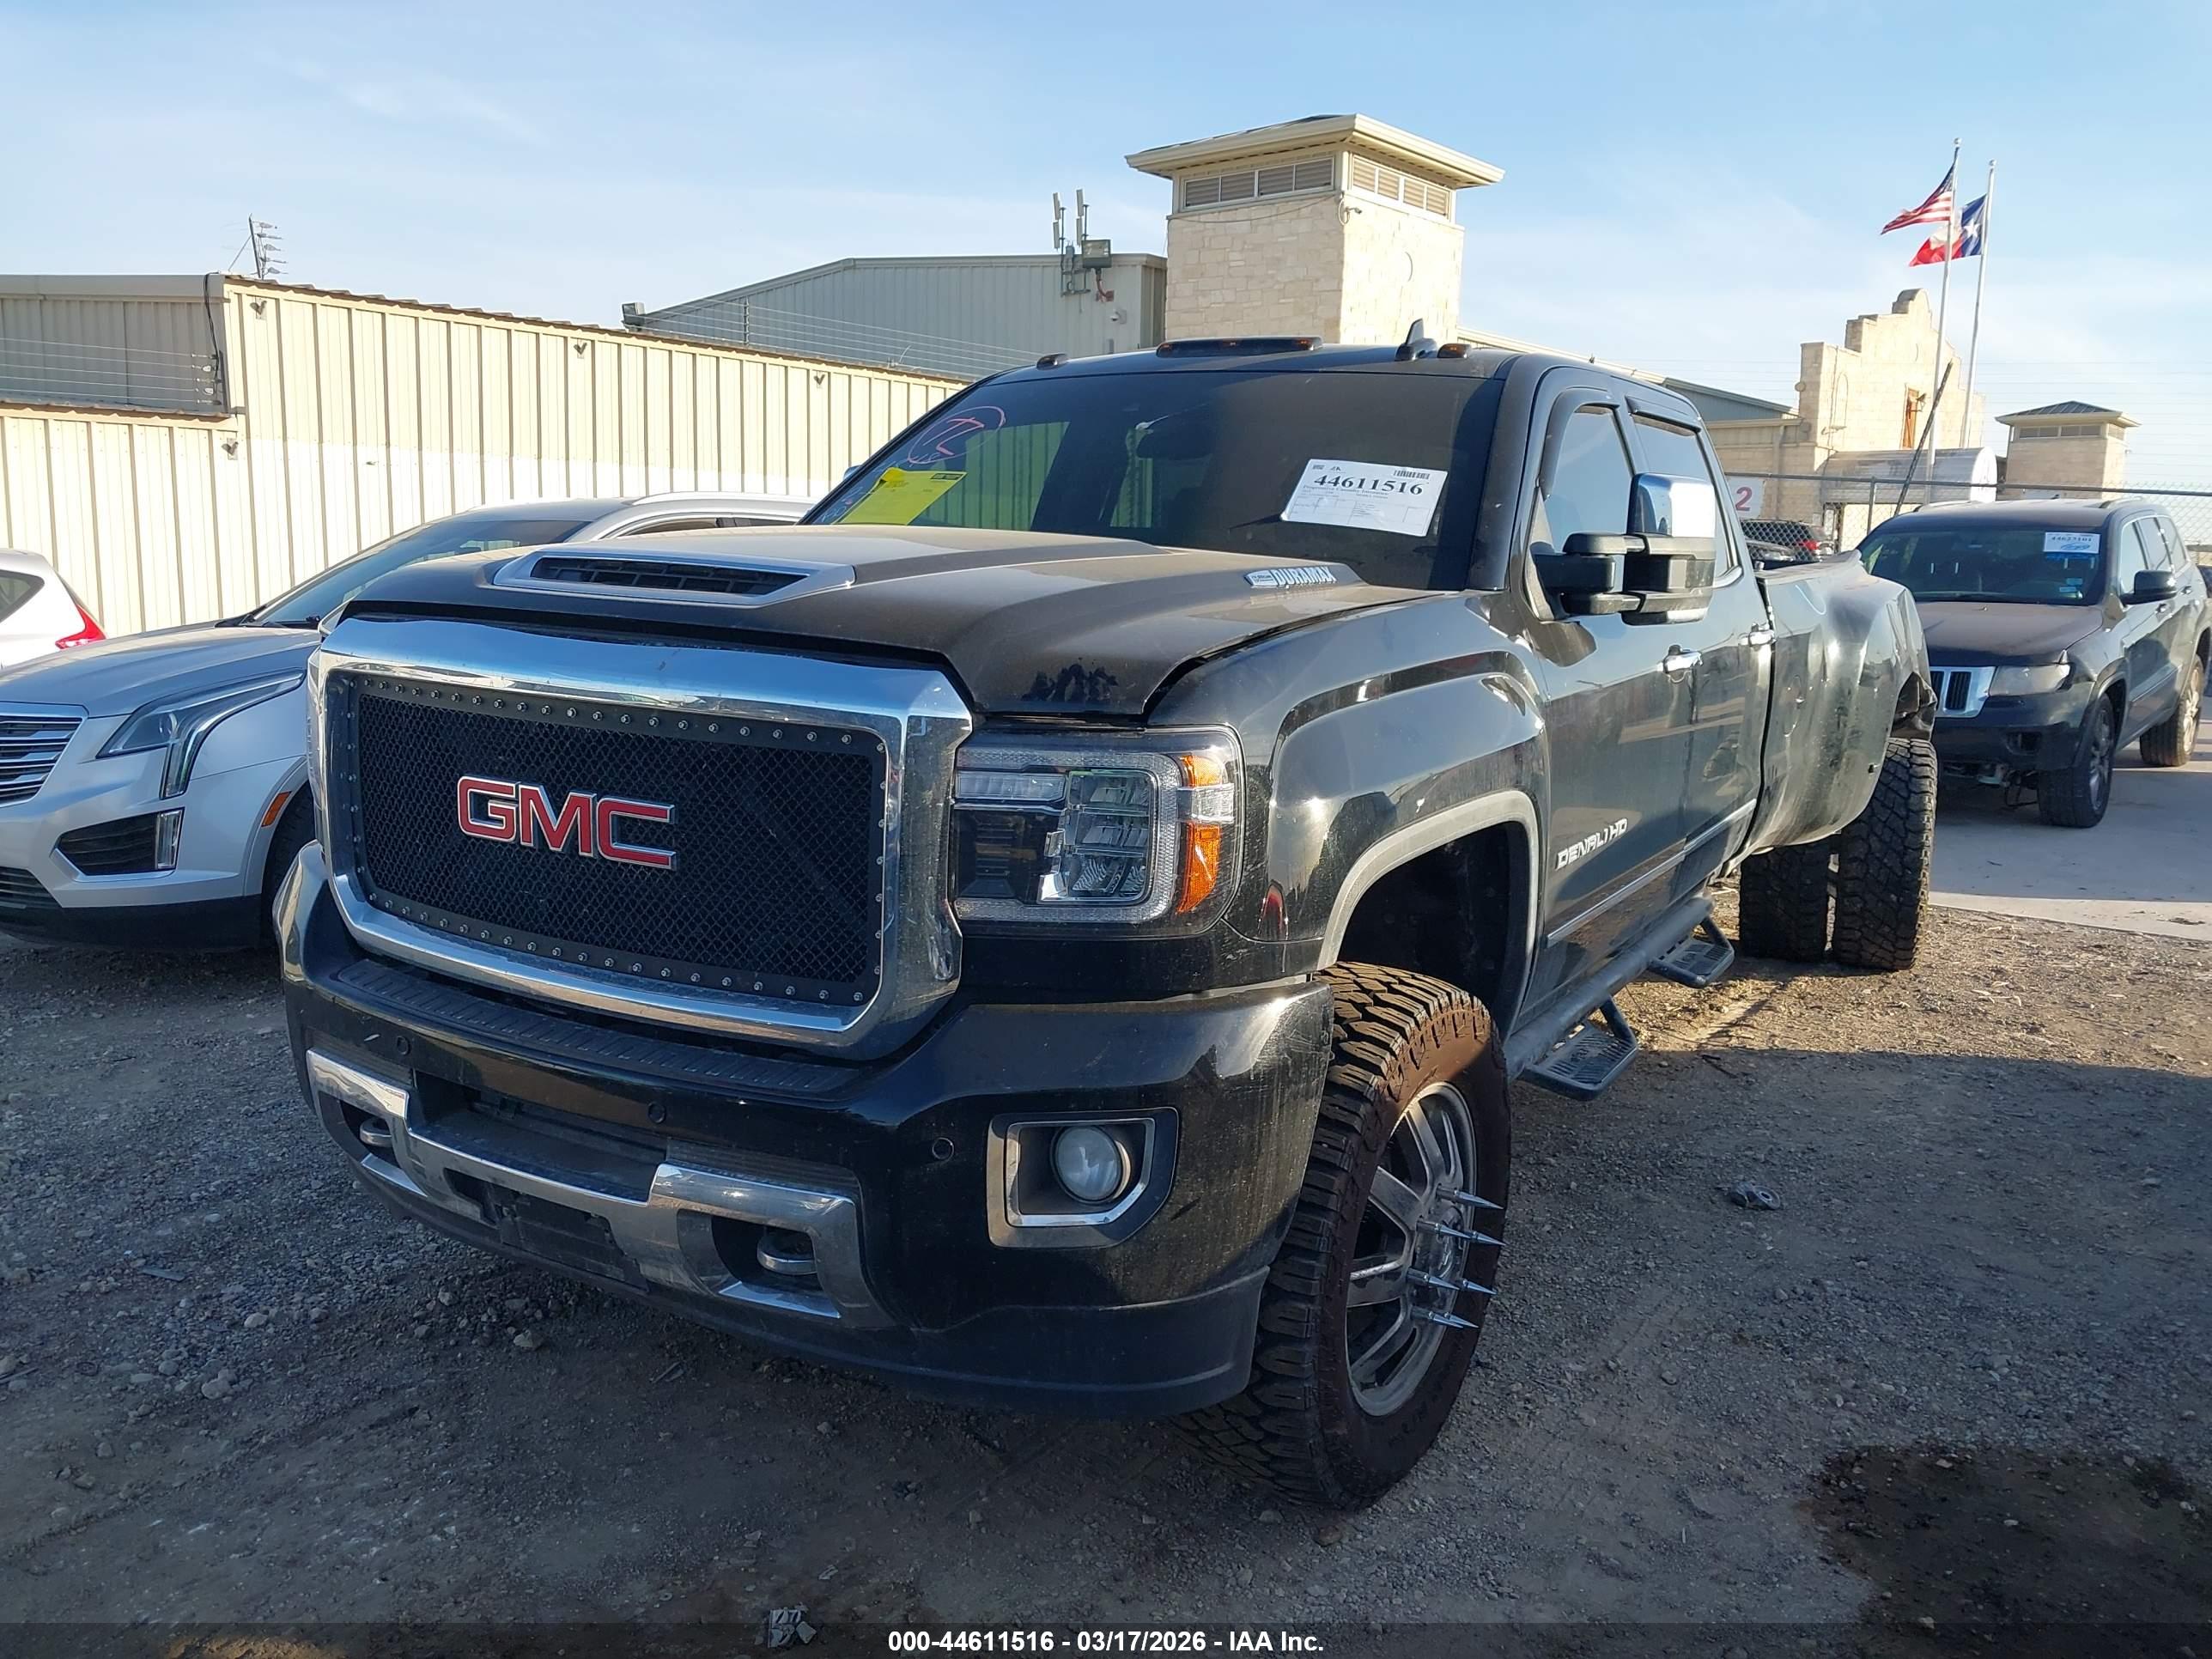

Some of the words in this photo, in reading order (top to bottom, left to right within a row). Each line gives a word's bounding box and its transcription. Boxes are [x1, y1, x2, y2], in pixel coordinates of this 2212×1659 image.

[1314, 475, 1425, 495] 44611516
[1735, 486, 1753, 511] 2
[1271, 566, 1338, 586] DURAMAX
[457, 775, 677, 870] GMC
[1555, 828, 1608, 871] DENALI
[1608, 817, 1628, 842] HD
